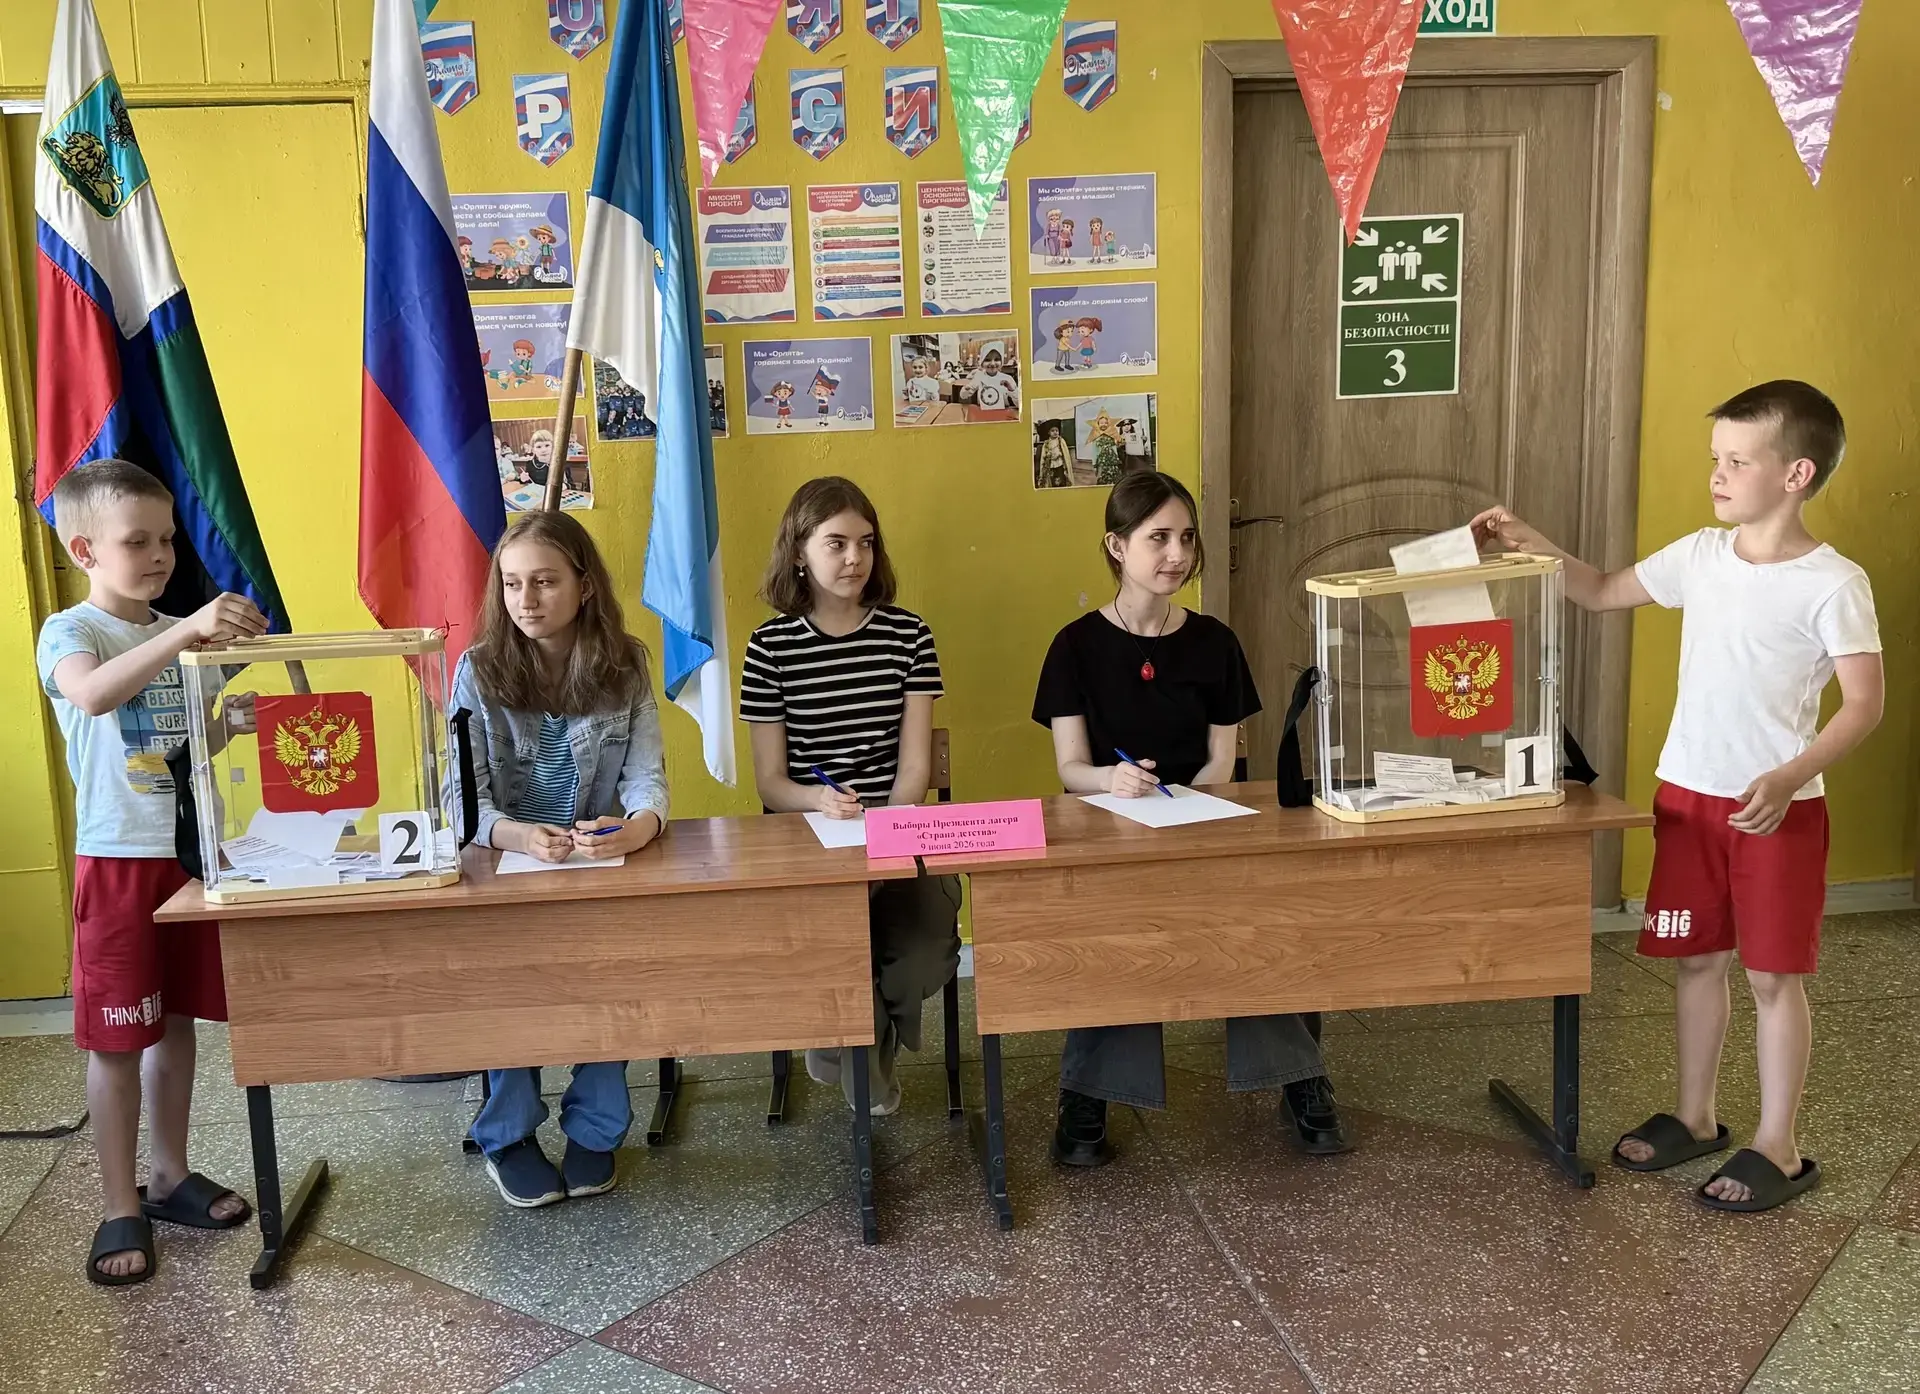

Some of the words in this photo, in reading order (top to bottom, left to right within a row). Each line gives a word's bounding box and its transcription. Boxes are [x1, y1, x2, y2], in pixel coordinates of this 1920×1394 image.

[1420, 0, 1488, 28] ХОД
[525, 94, 562, 138] Р
[800, 87, 837, 132] С
[892, 86, 930, 130] И
[474, 314, 507, 322] Орлята»
[1375, 312, 1410, 323] ЗОНА
[501, 323, 534, 331] учиться
[1344, 324, 1450, 339] БЕЗОПАСНОСТИ
[1383, 349, 1407, 386] 3
[155, 669, 174, 683] AT
[148, 690, 185, 706] BEACH
[1517, 744, 1540, 787] 1
[892, 821, 931, 831] Выборы
[933, 818, 986, 830] Президента
[987, 816, 1019, 826] лагеря
[391, 819, 421, 865] 2
[916, 831, 955, 841] «Страна
[957, 829, 997, 839] детства»
[928, 842, 952, 851] июня
[954, 840, 974, 849] 2026
[976, 840, 995, 848] года
[1656, 909, 1692, 938] BIG
[101, 1004, 143, 1027] THINK
